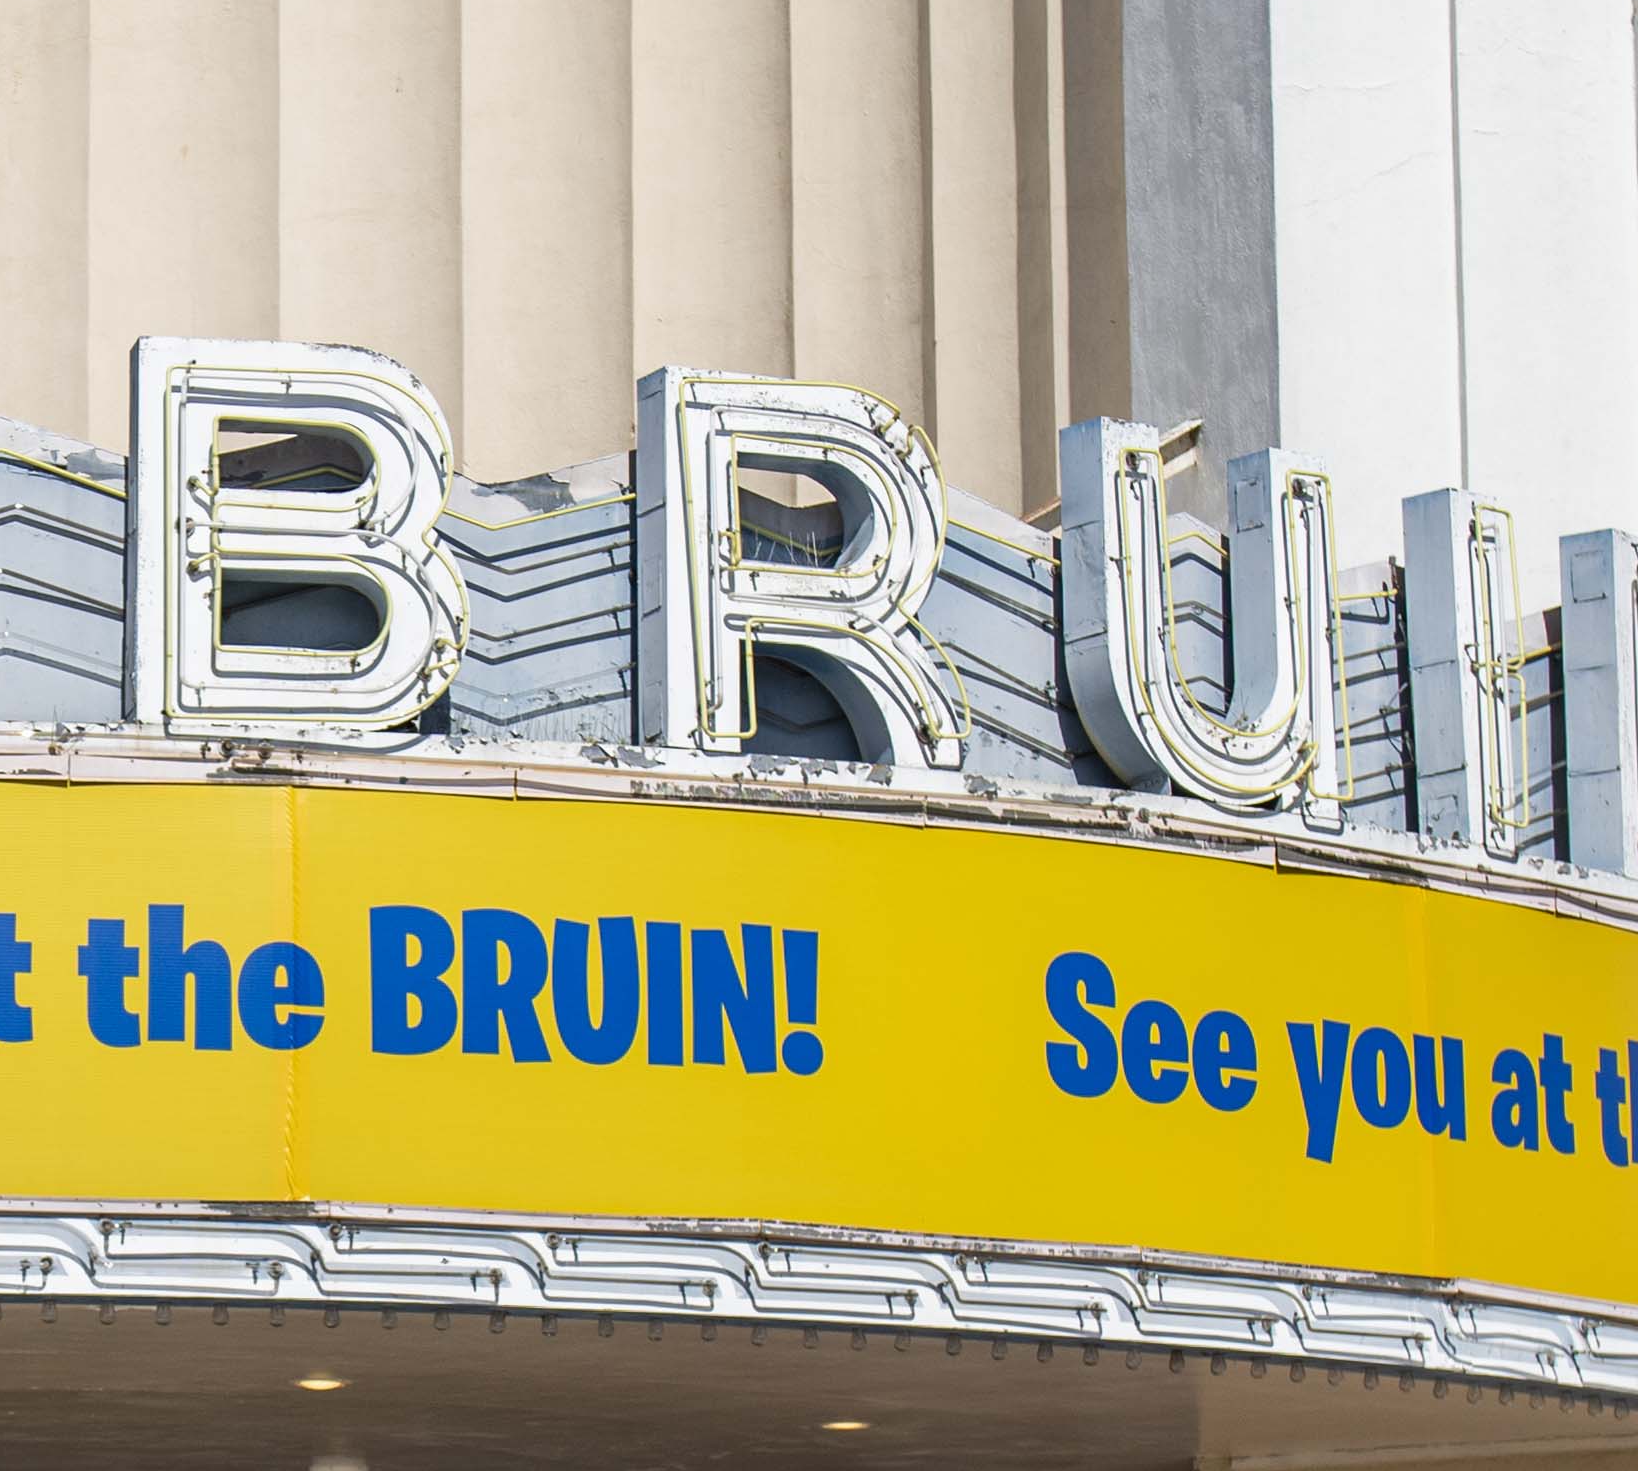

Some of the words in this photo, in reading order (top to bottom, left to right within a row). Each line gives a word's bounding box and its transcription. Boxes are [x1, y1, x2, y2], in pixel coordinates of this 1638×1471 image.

[77, 903, 325, 1052] the
[369, 905, 824, 1077] BRUIN!
[1045, 951, 1259, 1112] See
[1286, 1019, 1467, 1164] you
[1491, 1033, 1575, 1155] at
